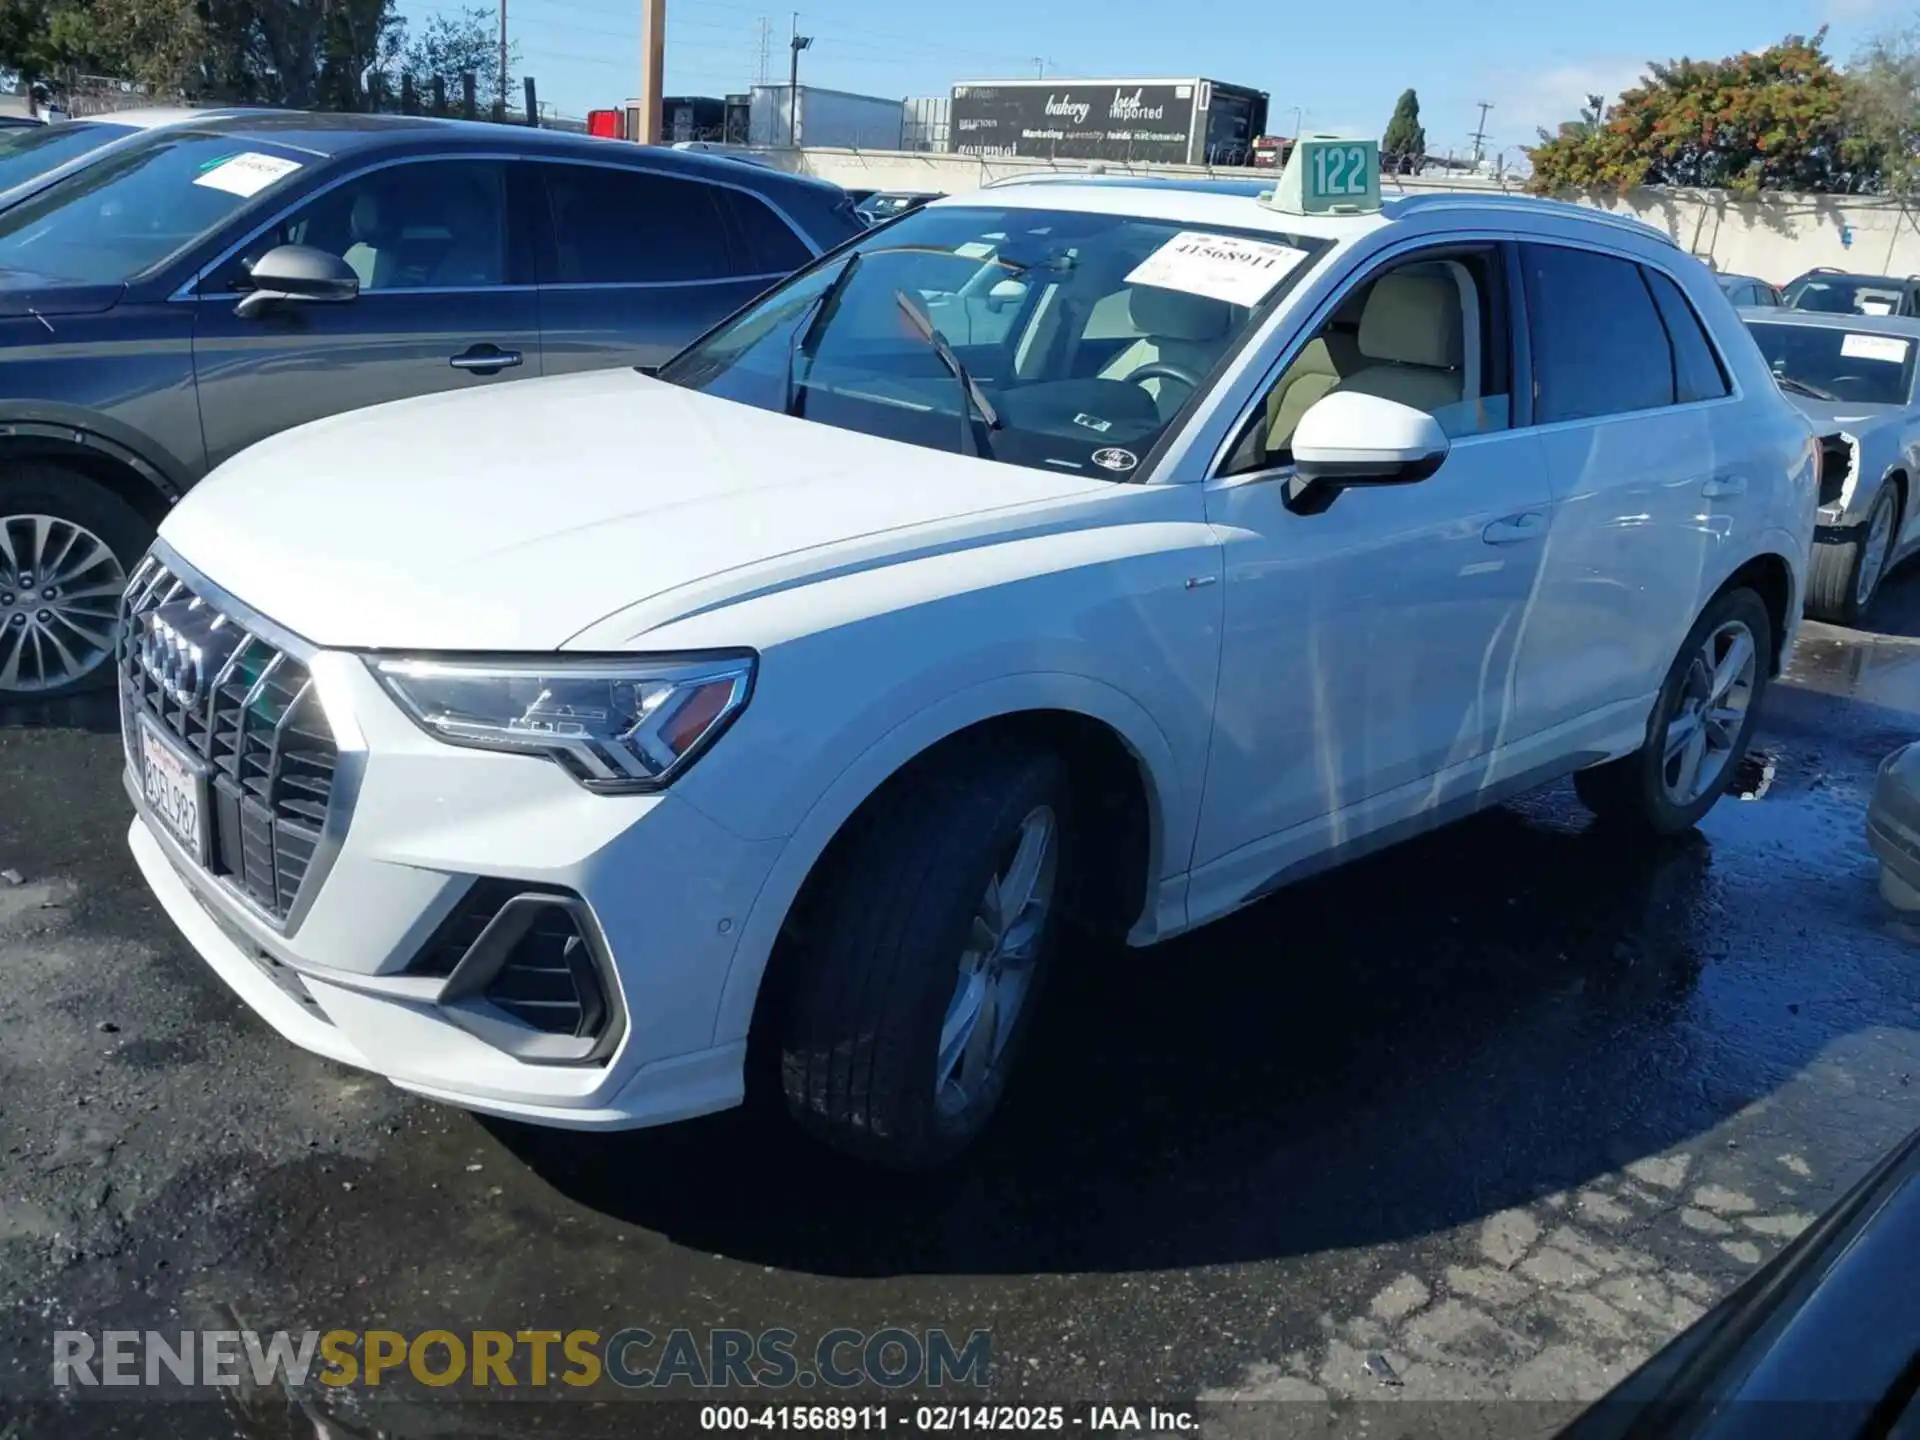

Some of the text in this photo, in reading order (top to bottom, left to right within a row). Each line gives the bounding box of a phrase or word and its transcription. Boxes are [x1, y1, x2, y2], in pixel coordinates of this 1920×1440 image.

[1044, 93, 1091, 124] bakery
[1108, 104, 1164, 121] imported
[1314, 146, 1366, 195] 122
